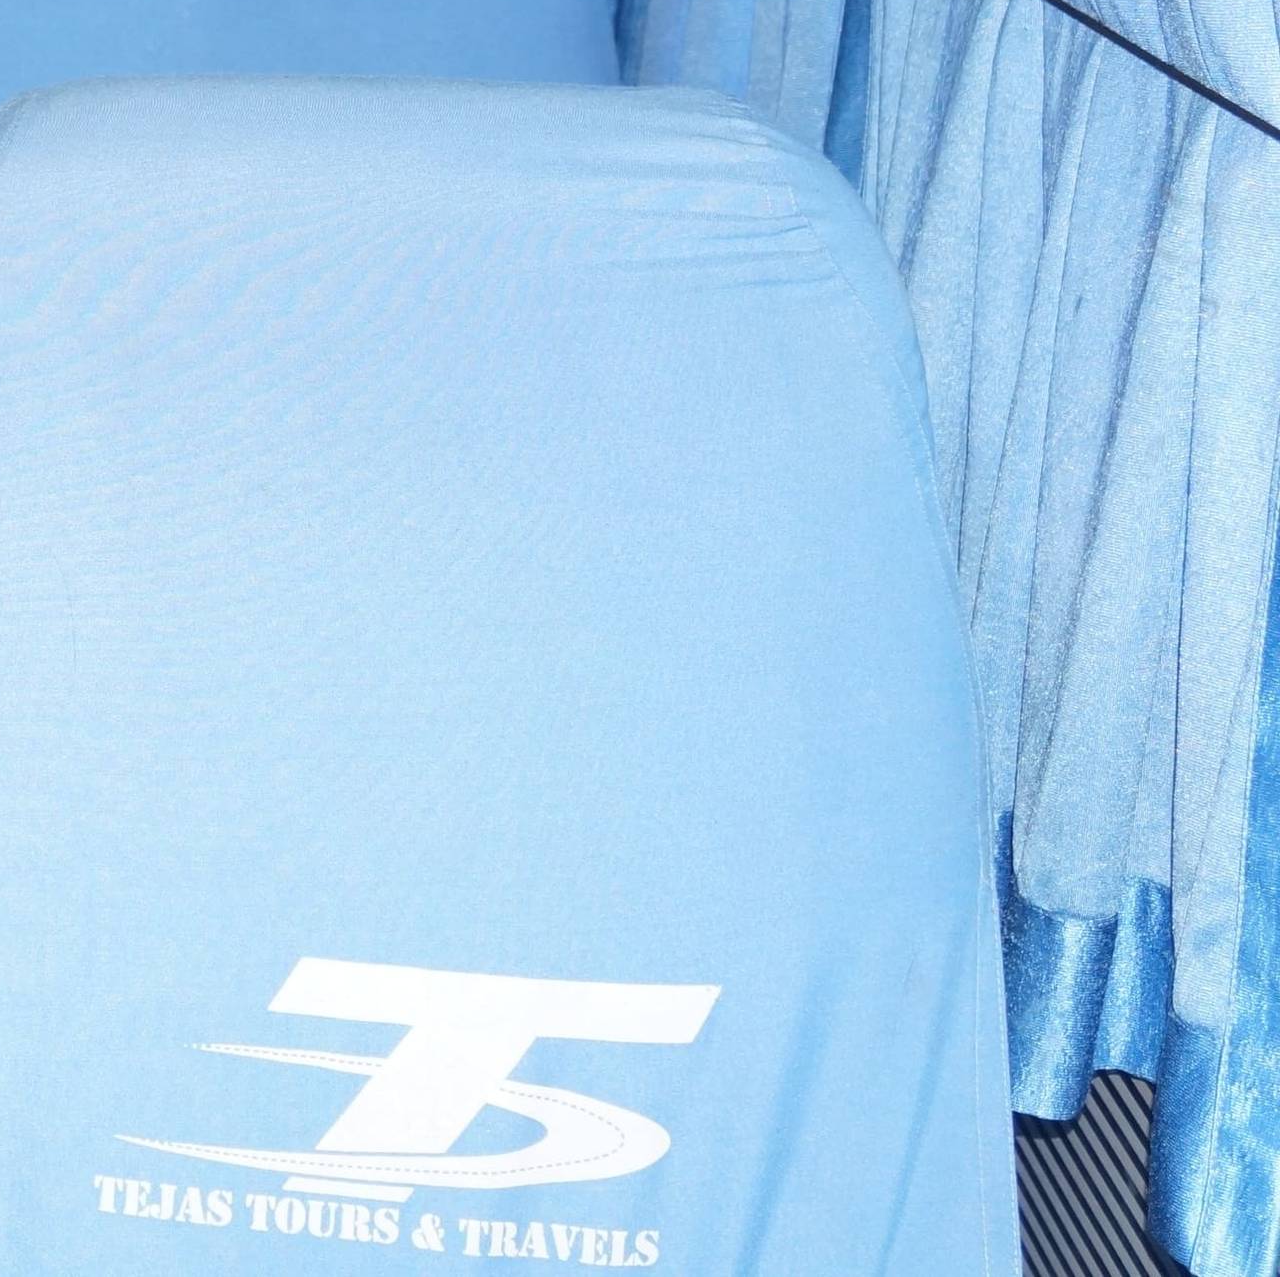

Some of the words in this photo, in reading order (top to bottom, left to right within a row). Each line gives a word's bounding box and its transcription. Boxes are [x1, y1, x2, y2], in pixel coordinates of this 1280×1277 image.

[94, 1174, 234, 1227] TEJAS
[246, 1193, 401, 1245] TOURS
[412, 1213, 445, 1253] &
[459, 1218, 661, 1267] TRAVELS
